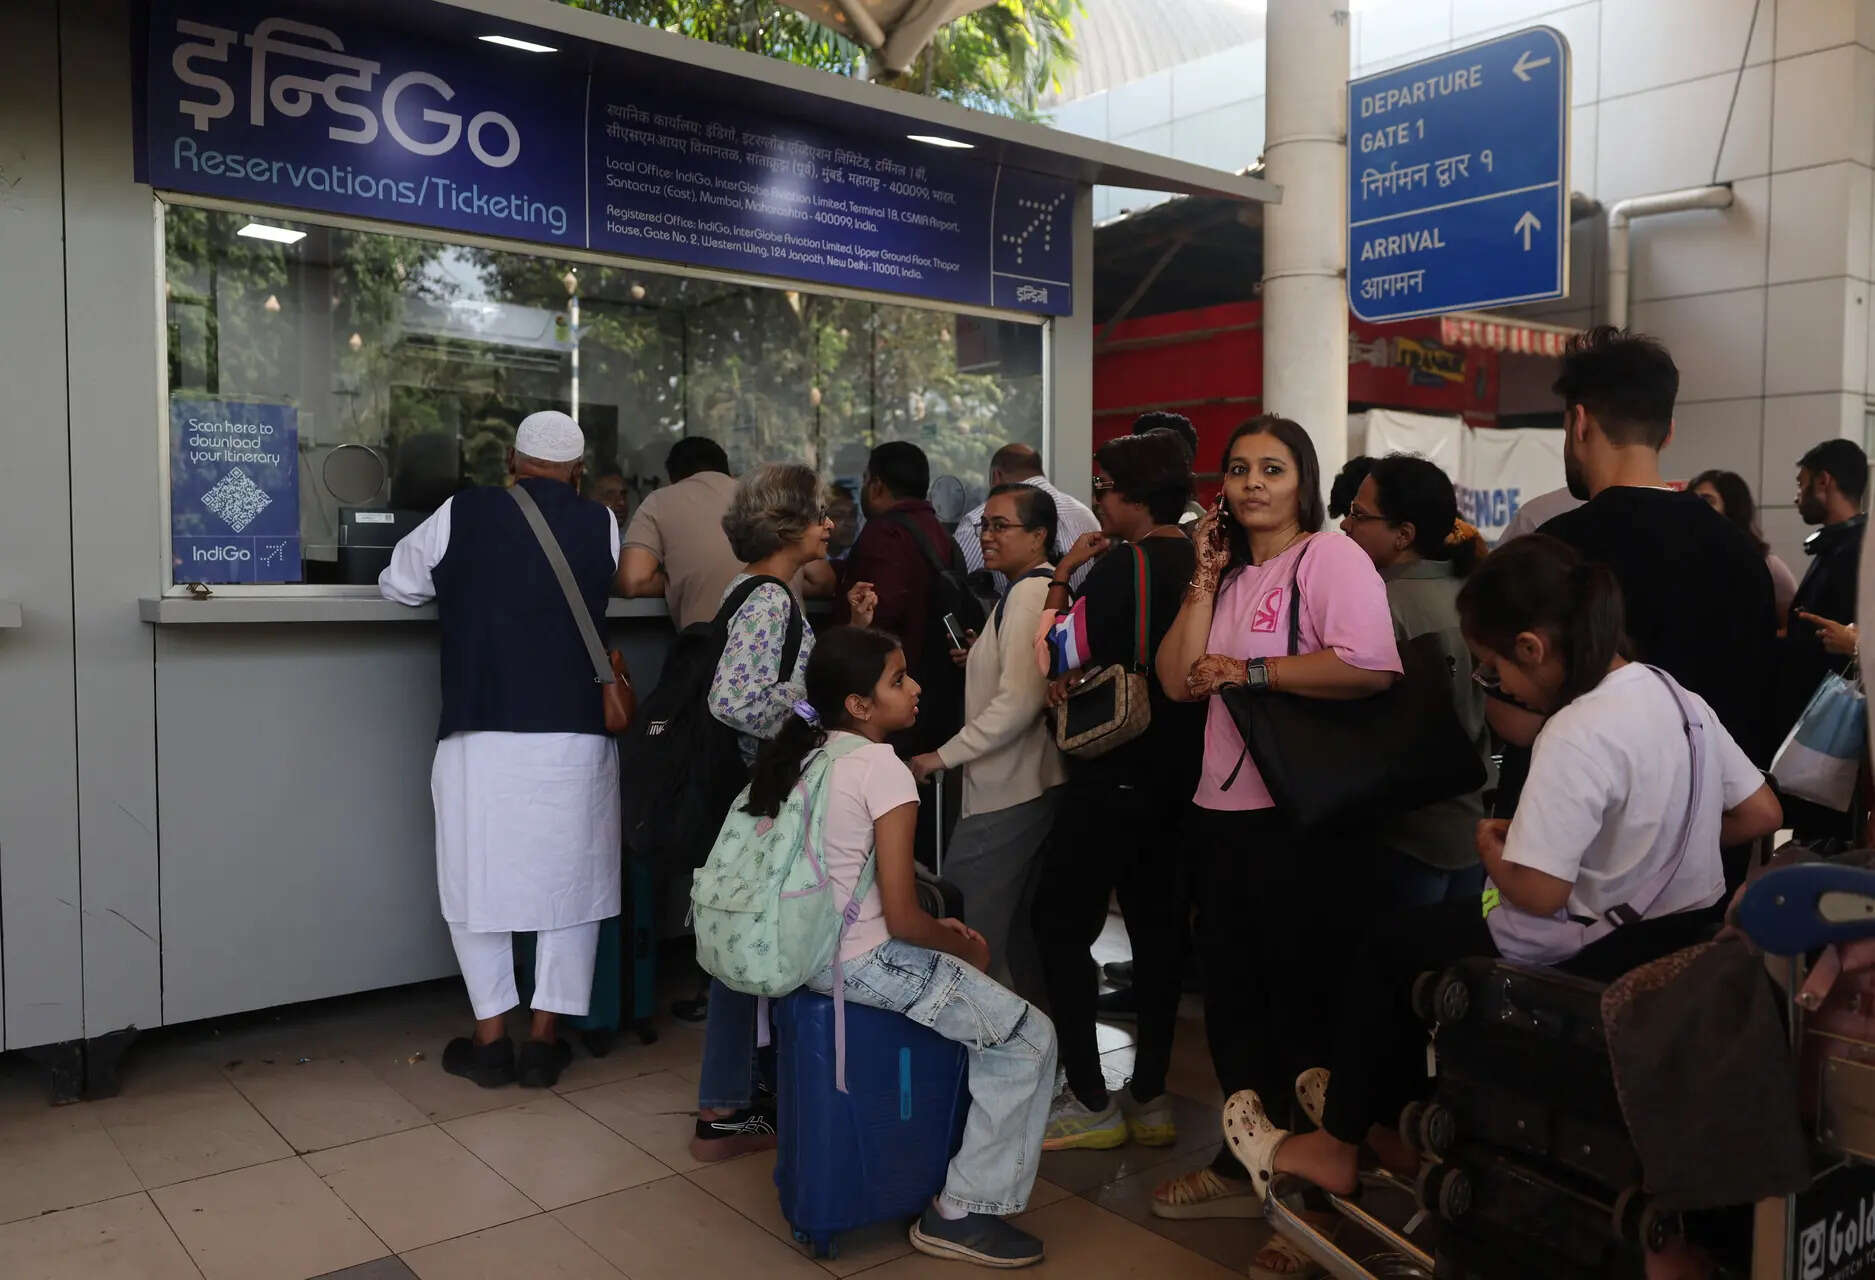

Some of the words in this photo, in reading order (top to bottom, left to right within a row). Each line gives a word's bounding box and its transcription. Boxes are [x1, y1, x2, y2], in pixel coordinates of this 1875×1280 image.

[1360, 65, 1483, 118] DEPARTURE
[1360, 123, 1410, 153] GATE
[1416, 118, 1425, 139] 1
[174, 136, 567, 234] Reservations/Ticketing
[606, 155, 634, 171] Local
[675, 168, 712, 186] IndiGo,
[812, 195, 847, 211] Limited,
[848, 201, 884, 217] Terminal
[889, 182, 929, 199] 400099,
[1361, 161, 1430, 200] निर्गमन
[1435, 154, 1471, 188] द्वार
[1479, 149, 1494, 173] १
[606, 174, 661, 193] Santacruz
[663, 185, 697, 202] (East),
[699, 191, 743, 209] Mumbai,
[814, 212, 853, 228] 400099,
[854, 218, 879, 232] India.
[606, 204, 662, 222] Registered
[663, 213, 696, 228] Office:
[698, 219, 732, 234] IndiGo,
[733, 225, 783, 241] InterGlobe
[784, 233, 820, 247] Aviation
[821, 239, 853, 254] Limited,
[854, 245, 879, 257] Upper
[880, 249, 911, 262] Ground
[607, 220, 642, 236] House,
[643, 226, 671, 240] Gate
[672, 230, 688, 243] No.
[690, 233, 699, 245] 2,
[701, 235, 742, 250] Western
[743, 242, 769, 257] Wing,
[770, 246, 786, 257] 124
[788, 249, 825, 264] Janpath,
[826, 255, 846, 267] New
[901, 267, 924, 278] India.
[1360, 228, 1446, 262] ARRIVAL
[1360, 269, 1425, 300] आगमन
[188, 418, 223, 433] Scan
[225, 420, 257, 435] here
[259, 422, 274, 435] to
[189, 434, 261, 449] download
[190, 451, 222, 464] your
[224, 451, 280, 467] Itinerary
[1457, 486, 1520, 527] ENCE
[192, 545, 251, 561] IndiGo
